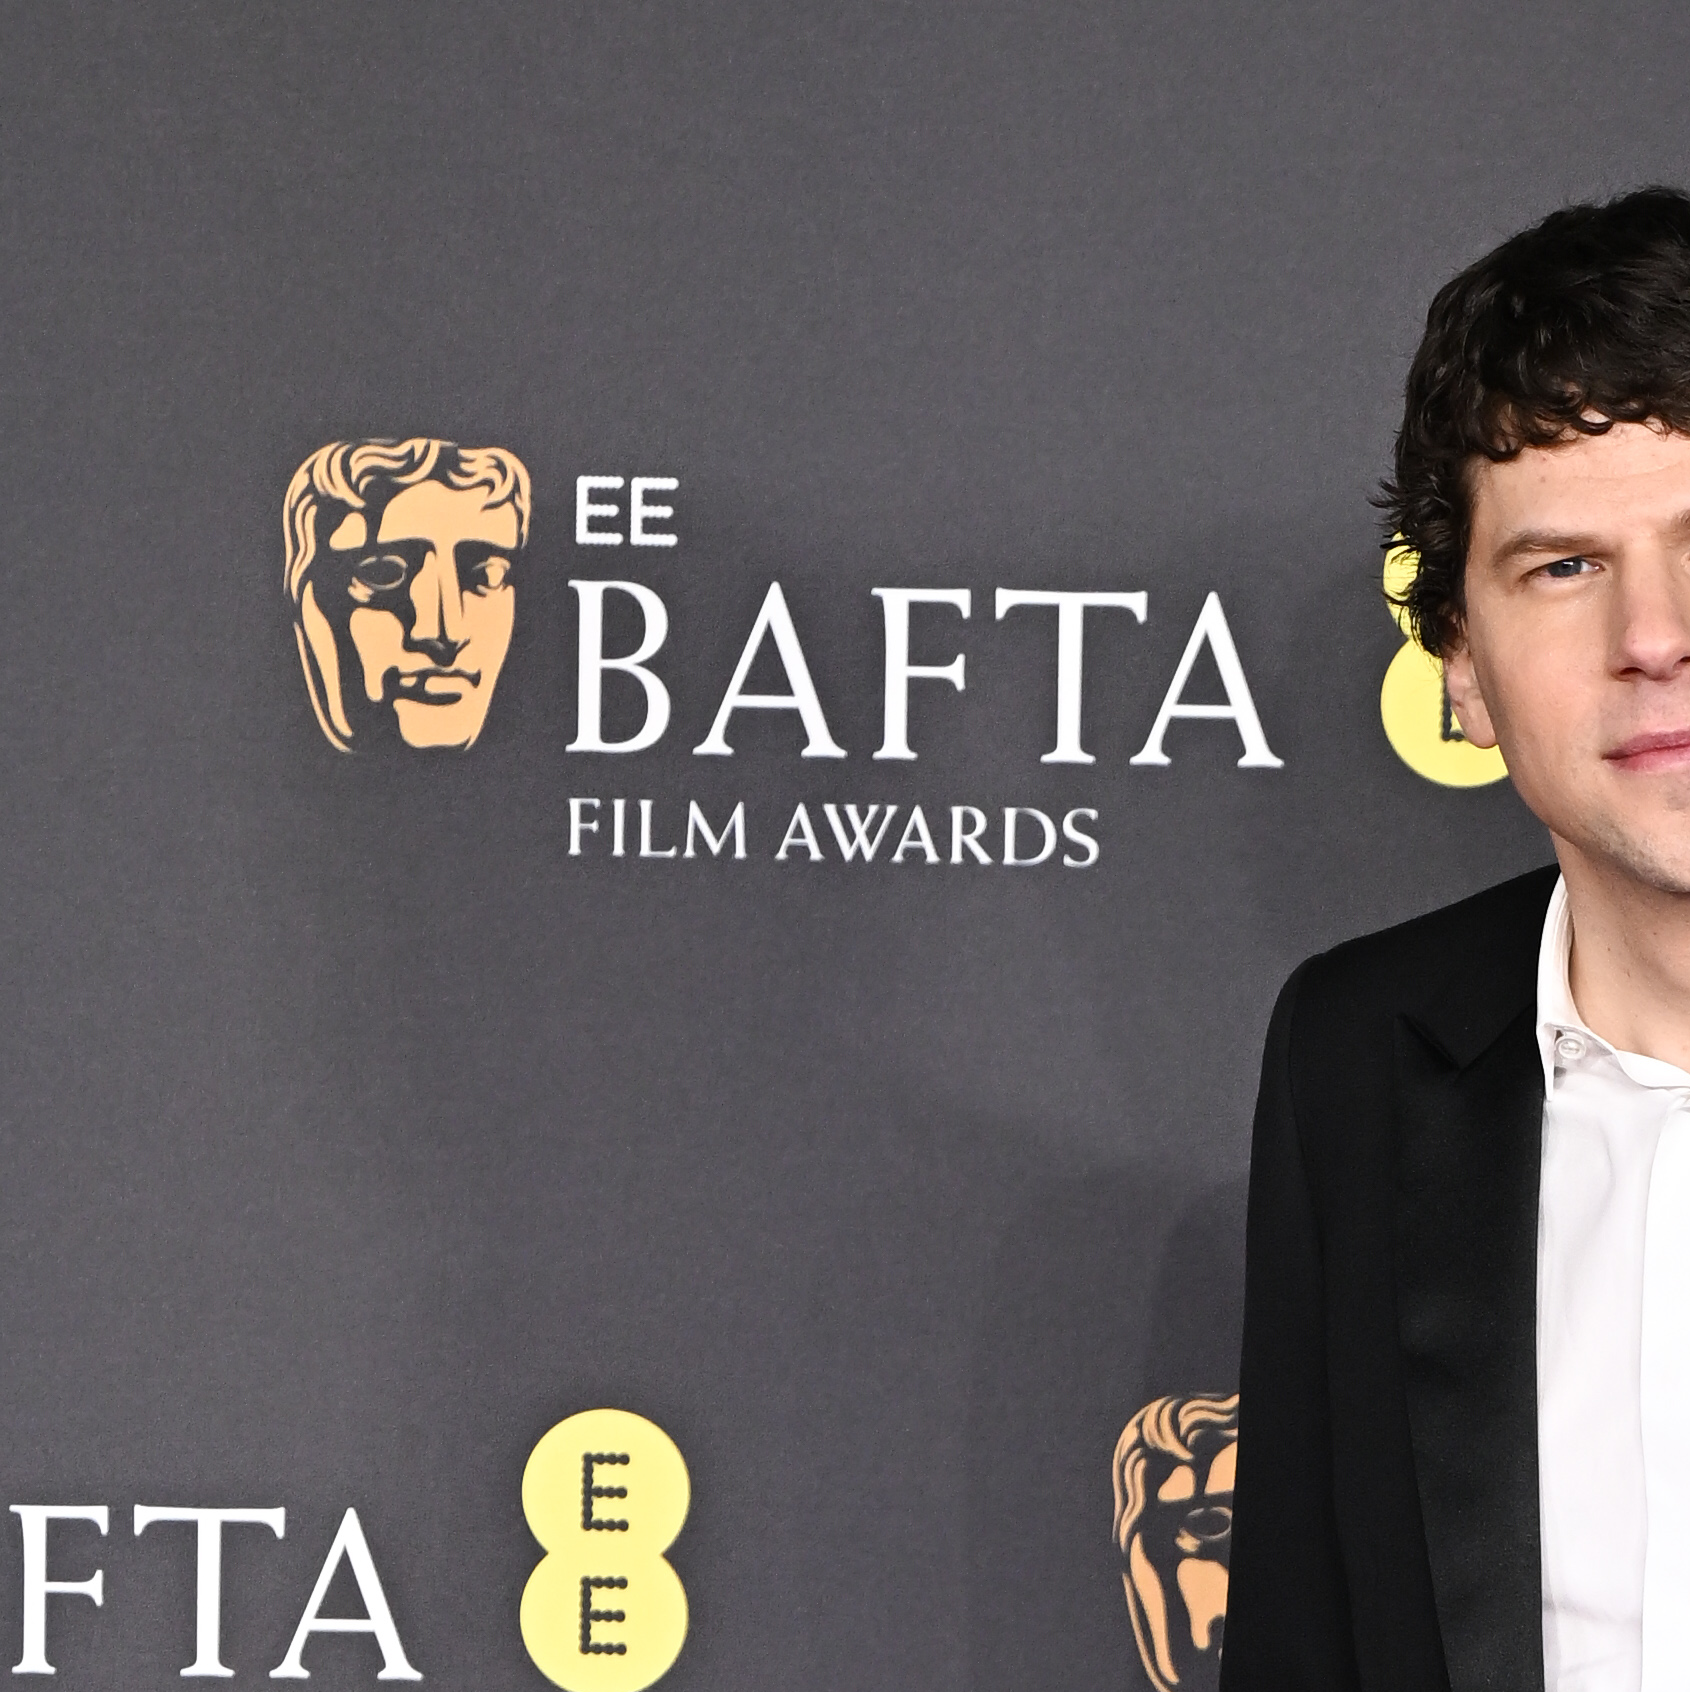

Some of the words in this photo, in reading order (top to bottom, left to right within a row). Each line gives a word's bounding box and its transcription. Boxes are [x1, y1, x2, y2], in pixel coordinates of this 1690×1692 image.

[575, 475, 679, 547] EE
[565, 579, 1285, 768] BAFTA
[568, 797, 747, 860] FILM
[774, 802, 1100, 868] AWARDS
[8, 1503, 424, 1682] FTA
